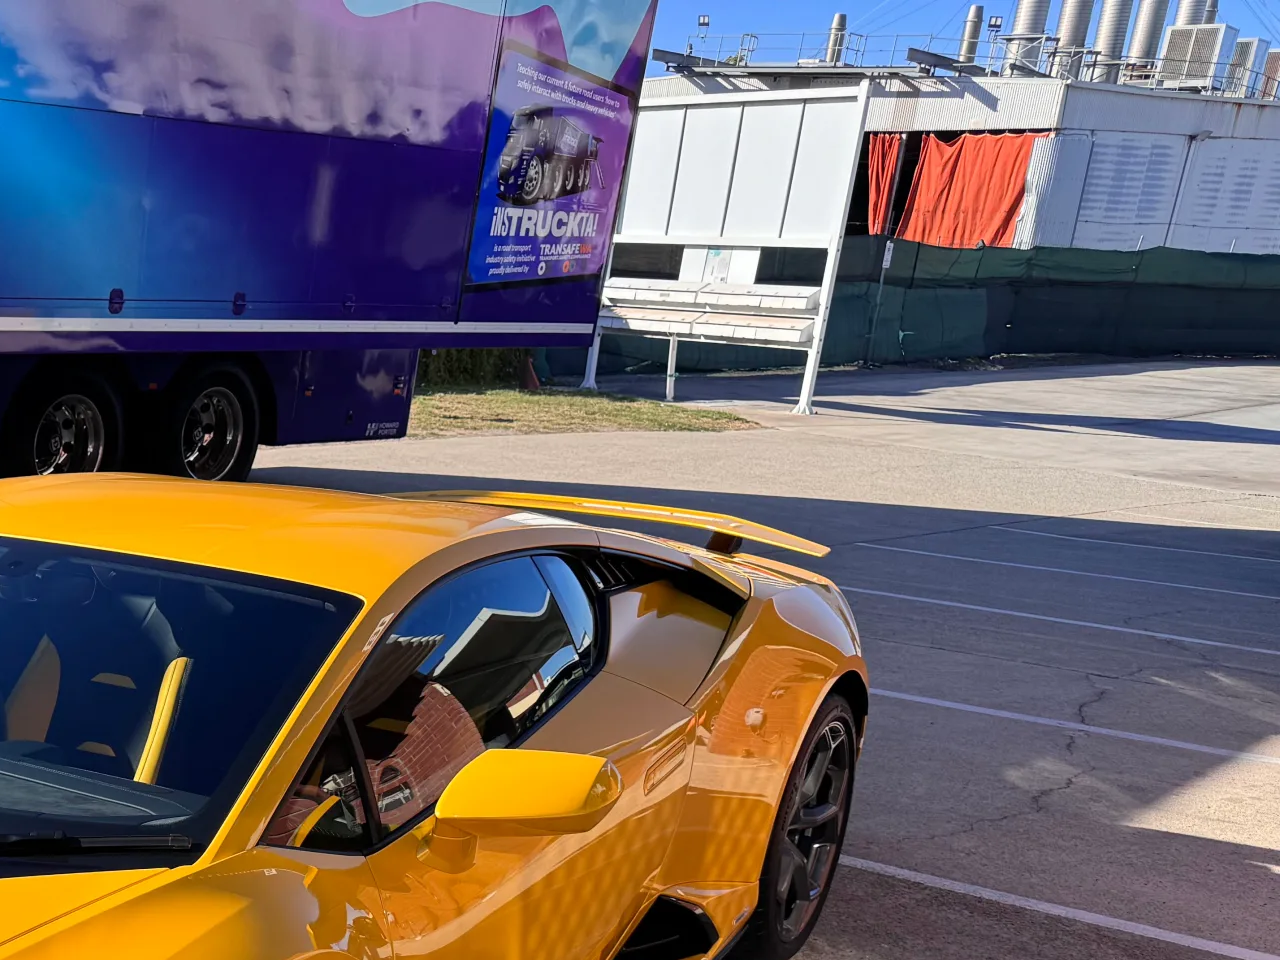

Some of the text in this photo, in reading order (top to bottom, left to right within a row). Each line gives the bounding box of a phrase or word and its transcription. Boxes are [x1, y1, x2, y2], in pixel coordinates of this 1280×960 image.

[516, 63, 538, 80] Teaching
[547, 75, 564, 88] current
[583, 88, 593, 99] road
[593, 93, 605, 103] users
